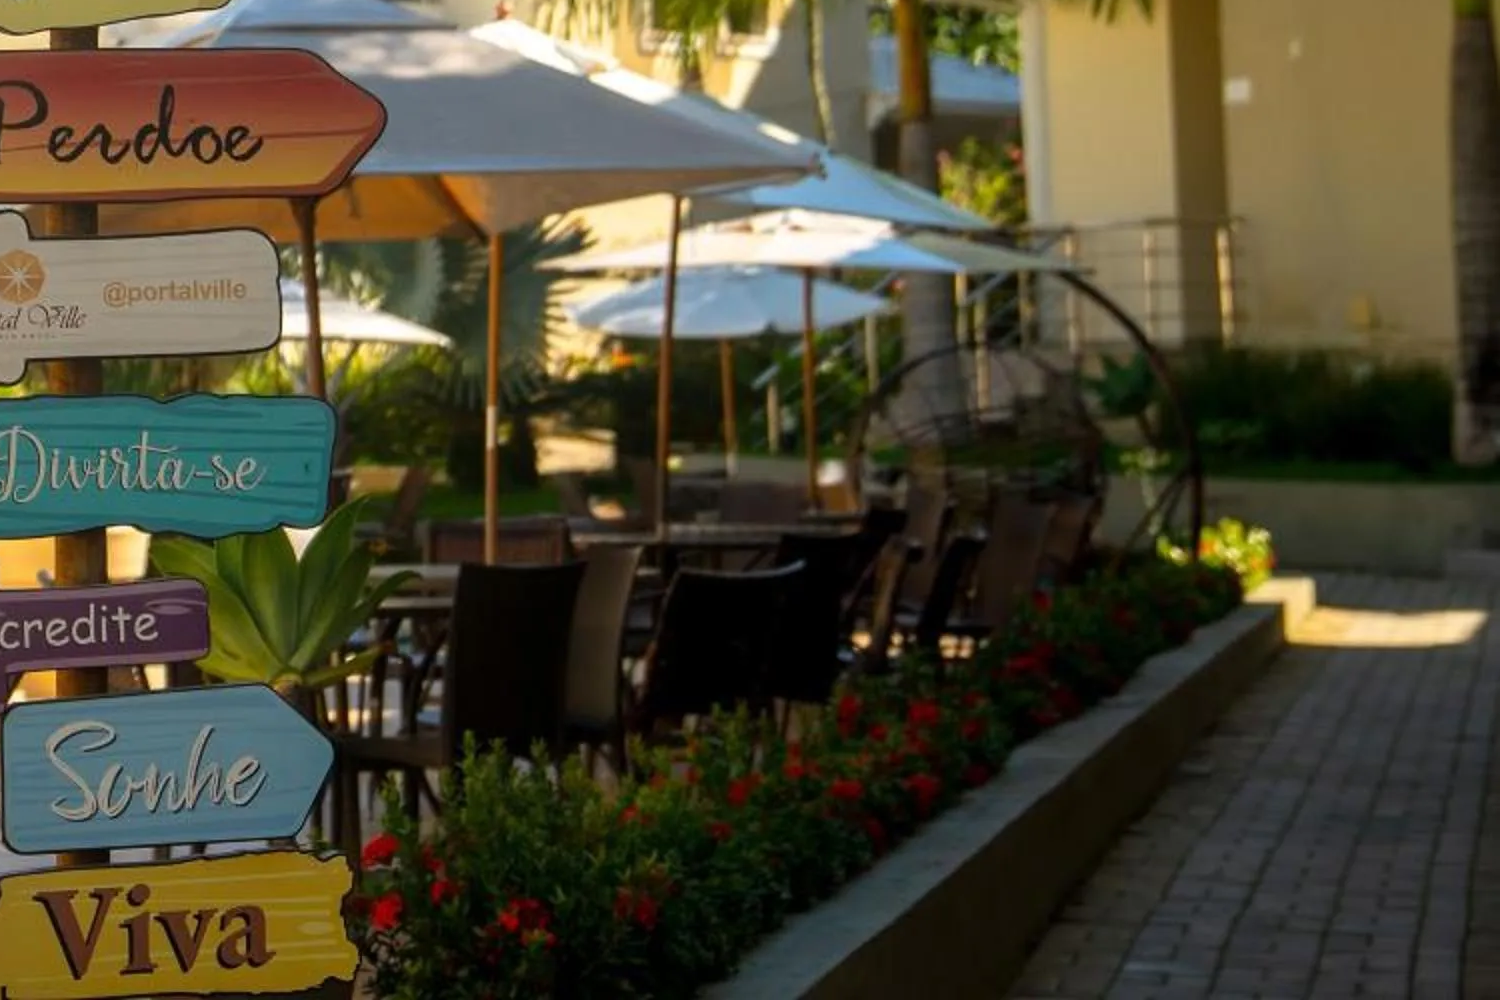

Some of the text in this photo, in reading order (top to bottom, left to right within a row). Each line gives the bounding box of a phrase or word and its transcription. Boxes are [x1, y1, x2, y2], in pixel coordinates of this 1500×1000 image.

[27, 303, 87, 329] Ville
[103, 279, 247, 308] @portalville
[44, 720, 268, 823] Sonhe
[32, 883, 276, 980] Viva
